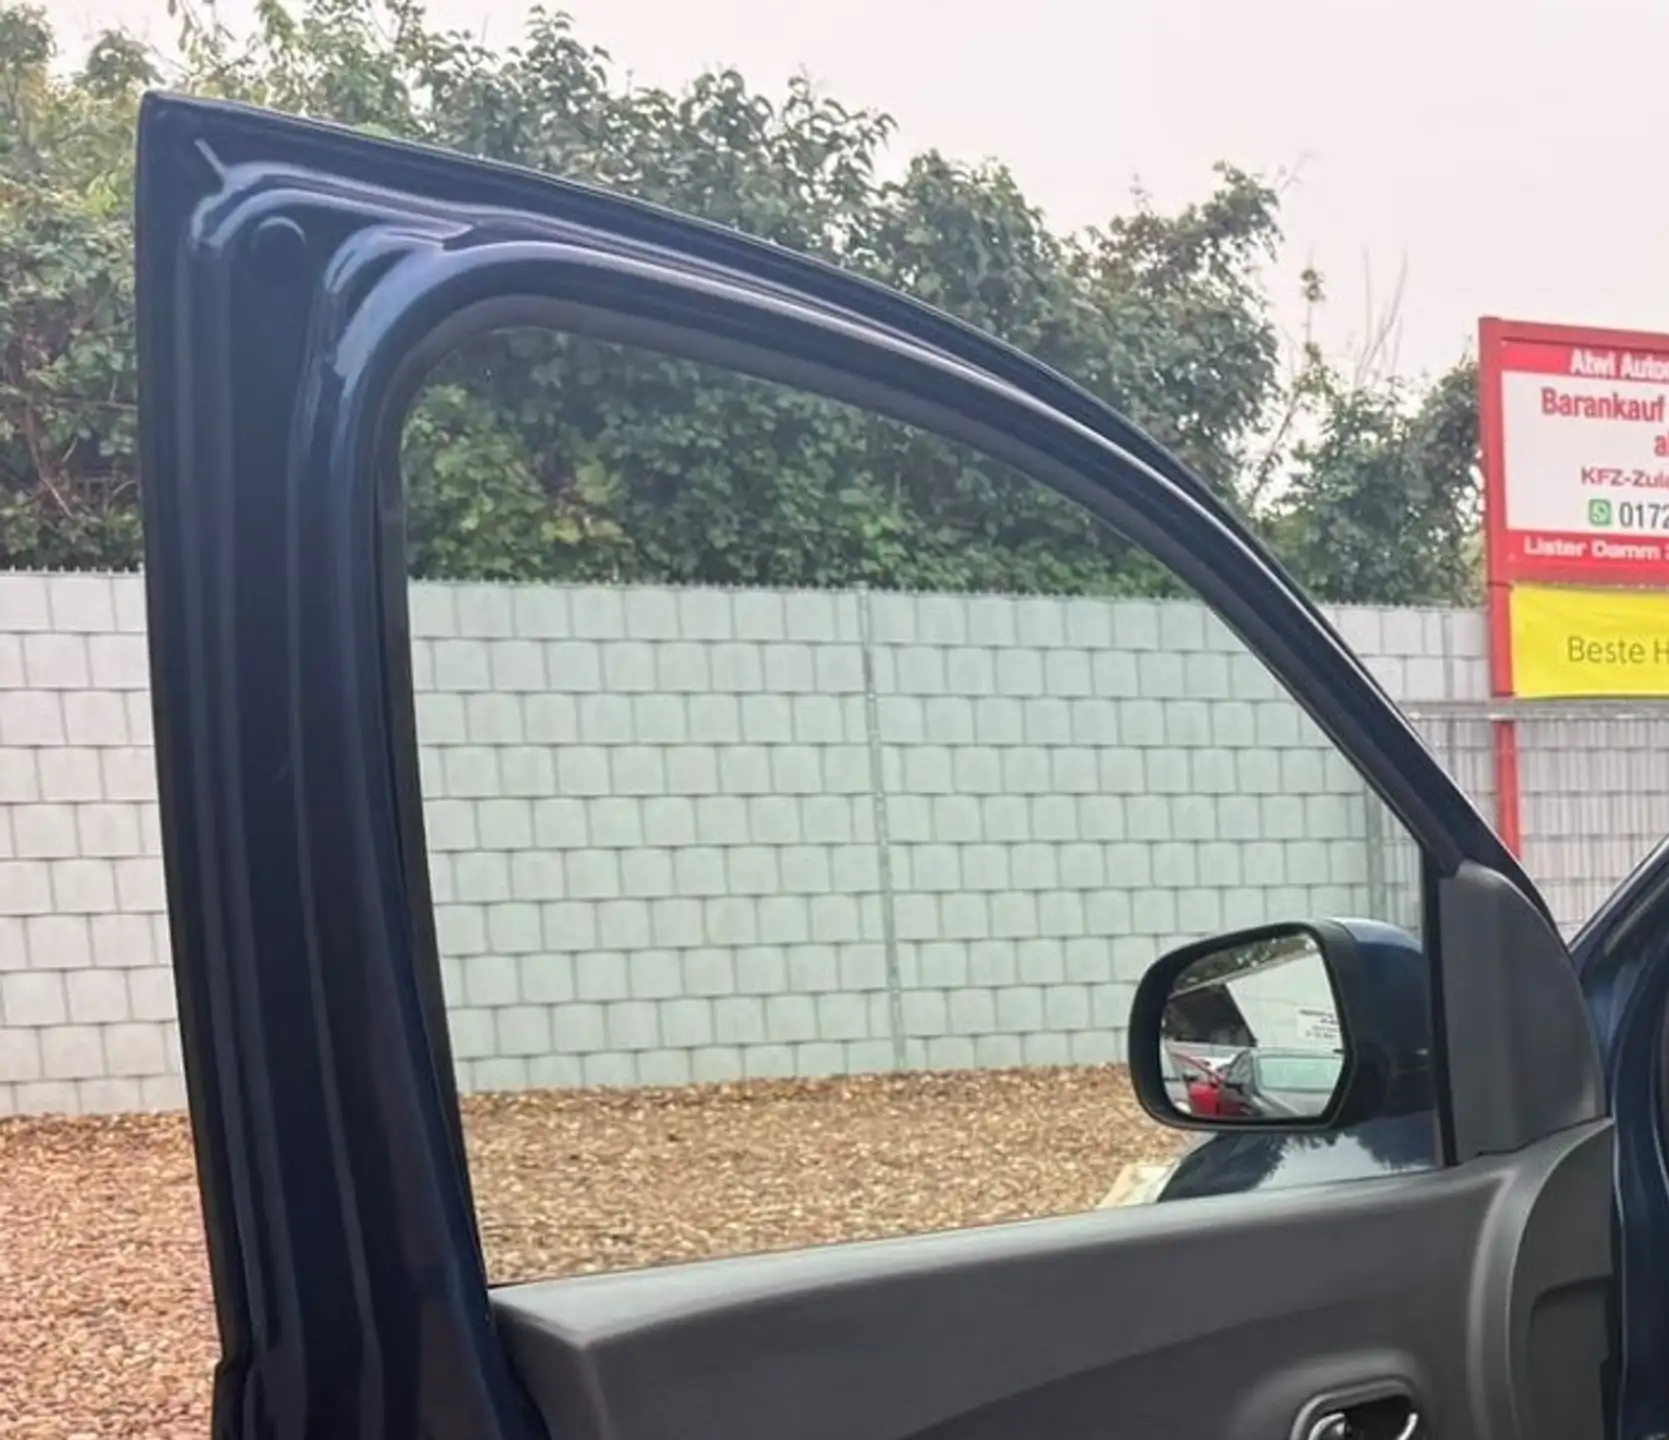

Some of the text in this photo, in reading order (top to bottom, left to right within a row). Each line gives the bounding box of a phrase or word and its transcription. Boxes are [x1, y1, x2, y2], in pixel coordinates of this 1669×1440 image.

[1541, 388, 1665, 424] Barankauf
[1524, 537, 1587, 558] Lister
[1592, 541, 1660, 560] Damm
[1567, 635, 1646, 664] Beste
